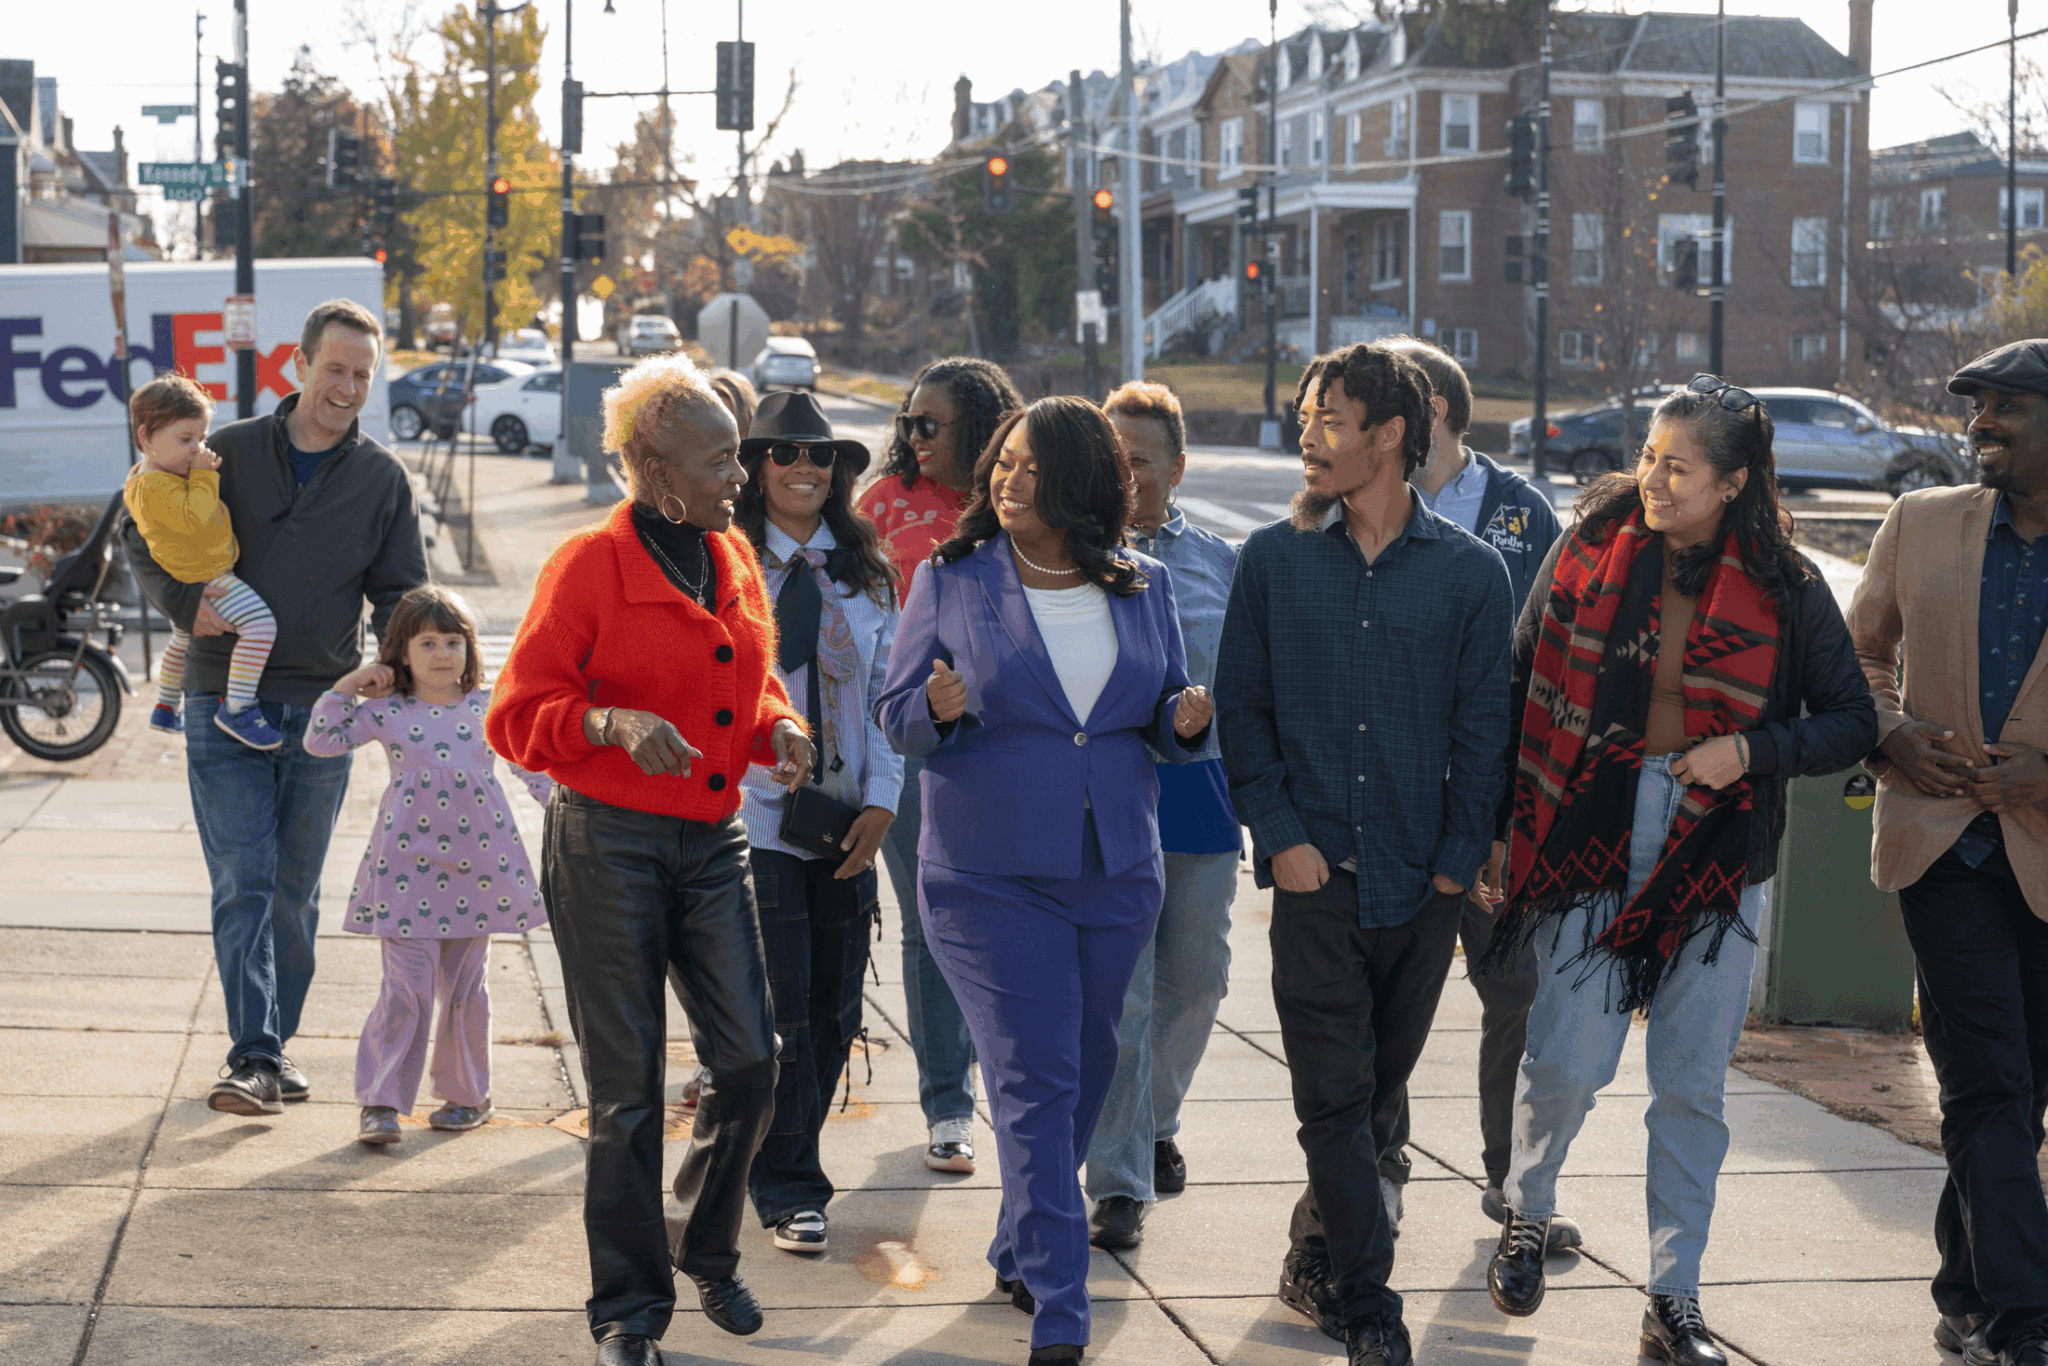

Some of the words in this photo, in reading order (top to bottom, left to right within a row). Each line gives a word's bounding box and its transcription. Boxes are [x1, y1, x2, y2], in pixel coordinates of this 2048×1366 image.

[143, 164, 207, 186] Kennedy
[168, 188, 202, 200] 100
[0, 312, 299, 411] FedEx
[1492, 534, 1532, 551] Panthes
